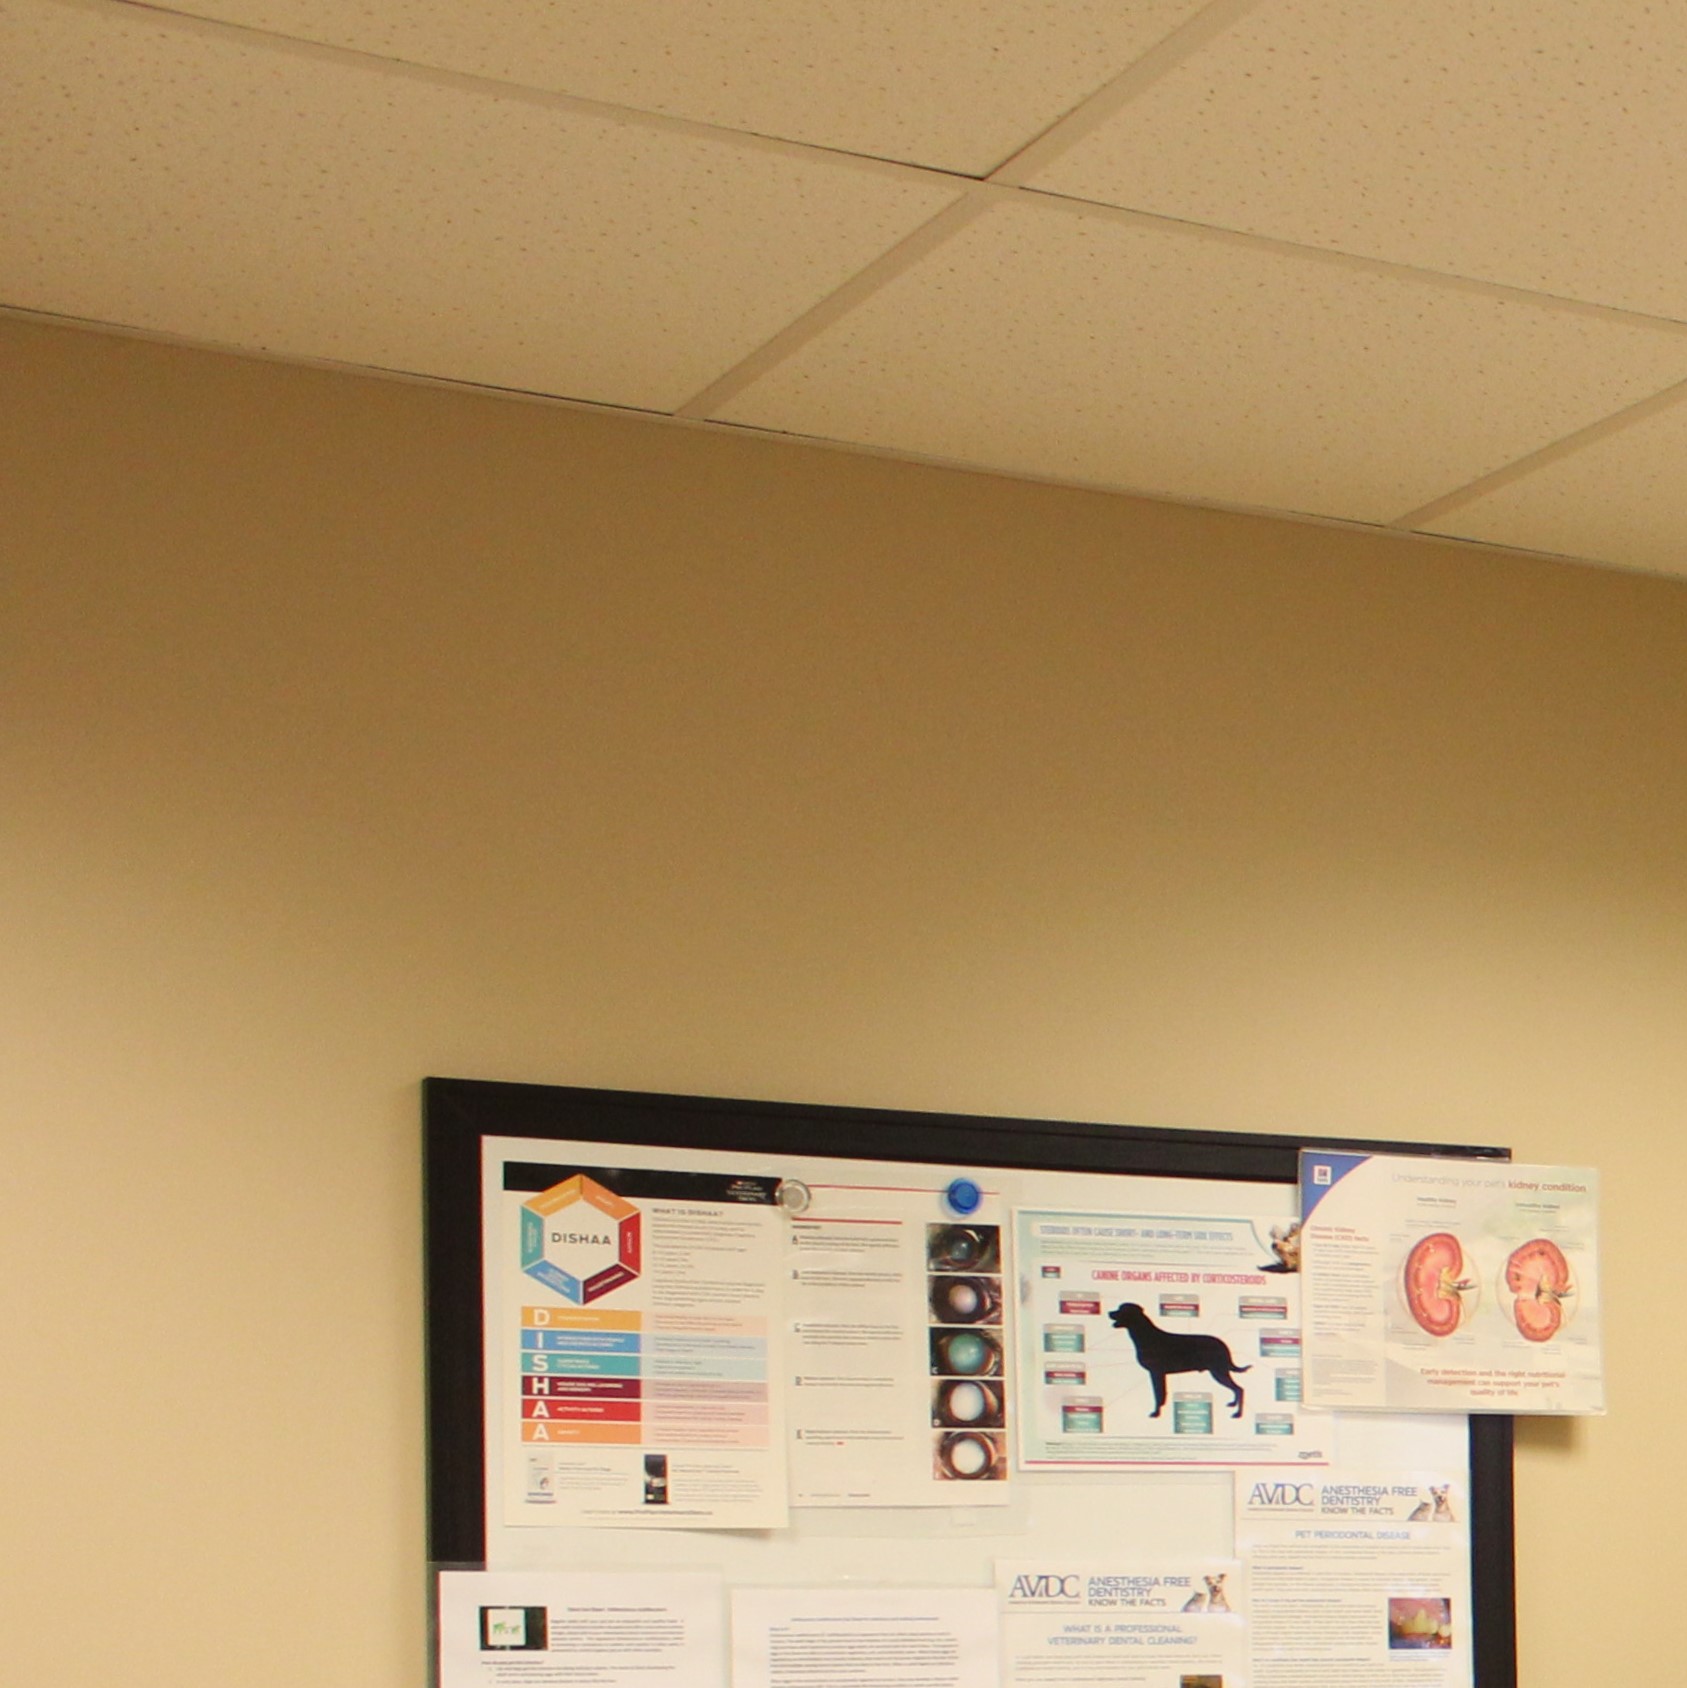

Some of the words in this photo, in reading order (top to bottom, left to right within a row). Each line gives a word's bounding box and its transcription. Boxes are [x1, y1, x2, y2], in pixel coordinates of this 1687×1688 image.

[1392, 1172, 1460, 1186] Understanding
[1462, 1177, 1482, 1188] your
[1508, 1180, 1540, 1193] kidney
[1542, 1181, 1587, 1193] condition
[551, 1232, 612, 1245] DISHAA
[1092, 1270, 1119, 1282] CANINE
[1154, 1272, 1189, 1284] AFFECTED
[534, 1309, 550, 1327] D
[532, 1354, 549, 1373] S
[532, 1377, 550, 1395] H
[532, 1400, 550, 1418] A
[532, 1423, 550, 1441] A
[1321, 1485, 1389, 1497] ANESTHESIA
[1392, 1487, 1418, 1497] FREE
[1321, 1496, 1381, 1506] DENTISTRY
[1321, 1507, 1348, 1515] KNOW
[1350, 1507, 1366, 1516] THE
[1368, 1507, 1394, 1516] FACTS
[1294, 1530, 1311, 1539] PET
[1314, 1530, 1374, 1540] PERIODONTAL
[1088, 1576, 1162, 1587] ANESTHESIA
[1164, 1576, 1192, 1587] FREE
[1088, 1587, 1152, 1598] DENTISTRY
[1088, 1598, 1117, 1607] KNOW
[1119, 1598, 1137, 1607] THE
[1139, 1598, 1167, 1607] FACTS
[1063, 1624, 1092, 1633] WHAT
[1114, 1624, 1182, 1634] PROFESSIONAL
[1047, 1636, 1105, 1645] VETERINARY
[1108, 1636, 1144, 1645] DENTAL
